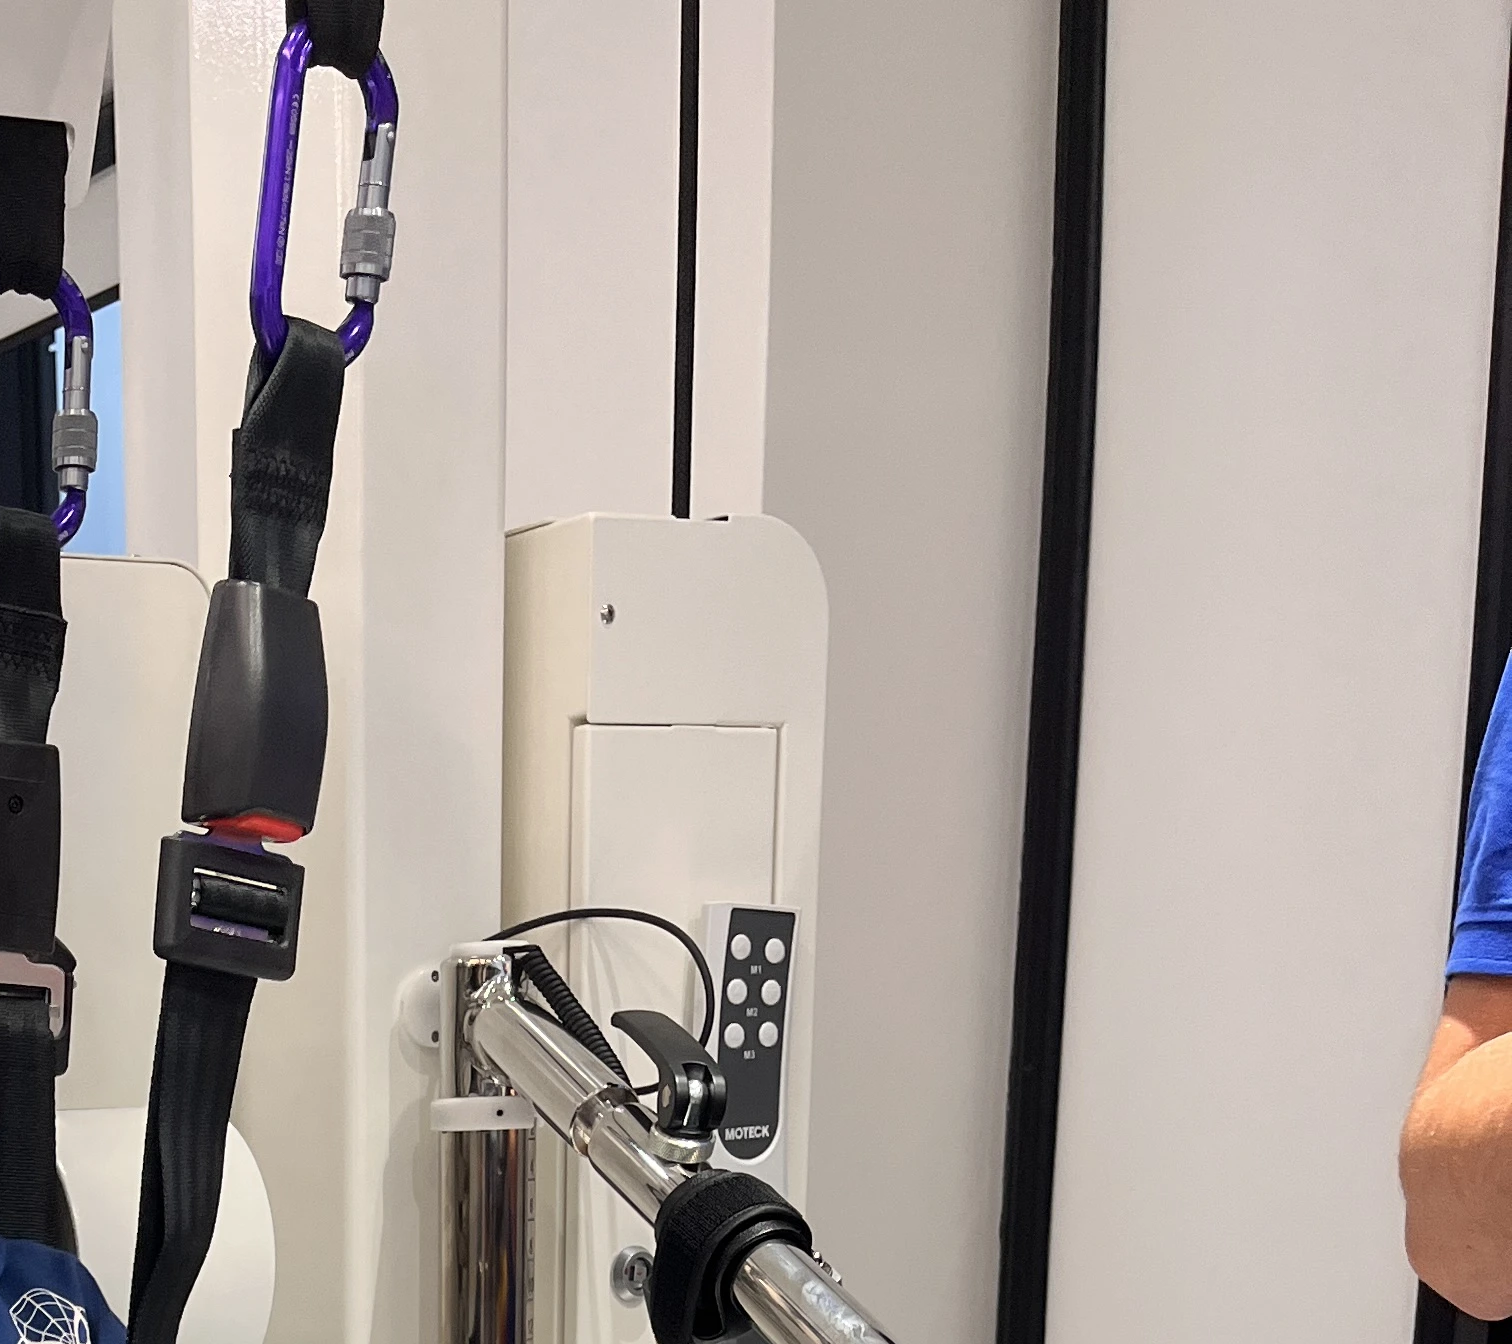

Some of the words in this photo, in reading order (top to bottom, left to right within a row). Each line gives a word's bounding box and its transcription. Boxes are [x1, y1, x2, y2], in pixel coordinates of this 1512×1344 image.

[750, 965, 762, 975] M1
[746, 1008, 758, 1017] M2
[725, 1125, 770, 1141] MOTECK
